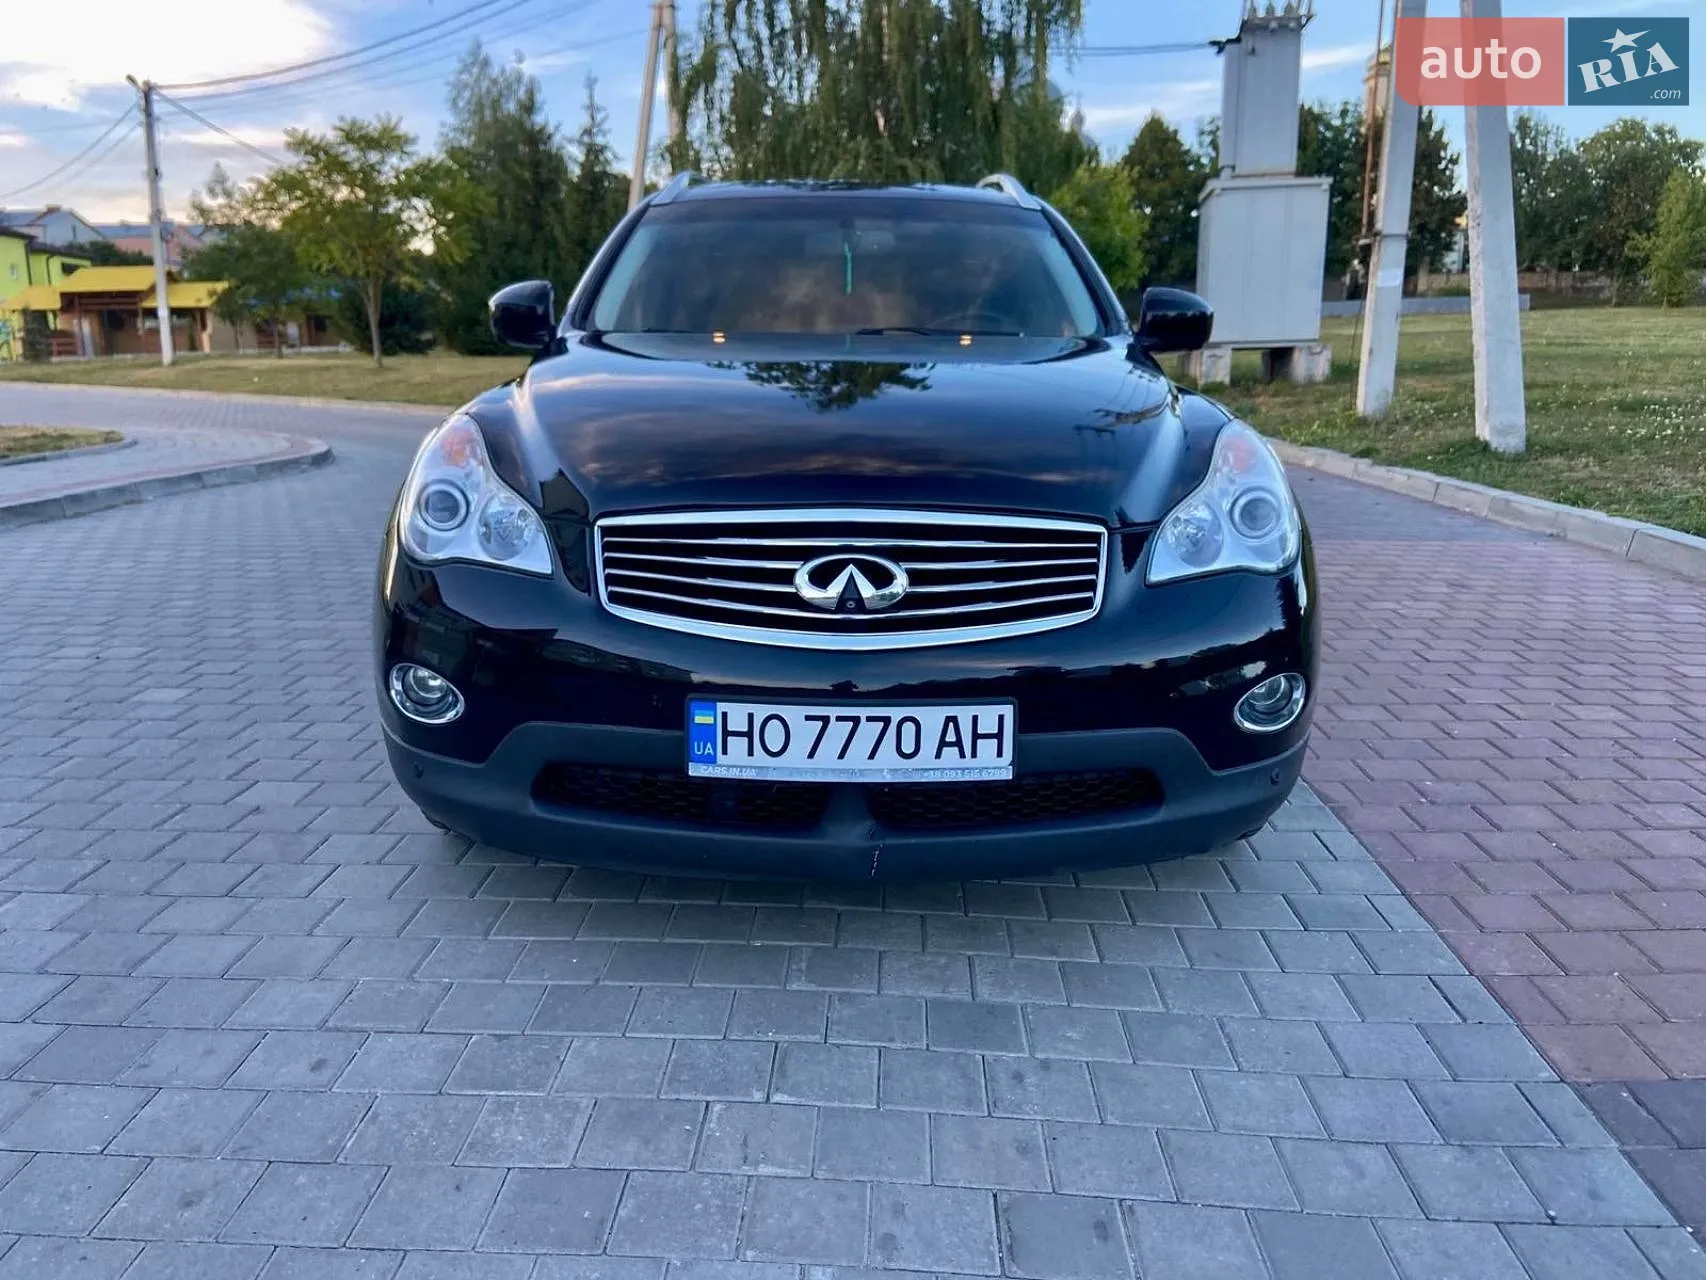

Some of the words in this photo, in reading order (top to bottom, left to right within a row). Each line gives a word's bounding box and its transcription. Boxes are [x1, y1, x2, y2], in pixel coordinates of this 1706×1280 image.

[694, 742, 714, 755] UA
[721, 711, 792, 758] HO
[804, 714, 922, 761] 7770
[934, 713, 1005, 760] AH
